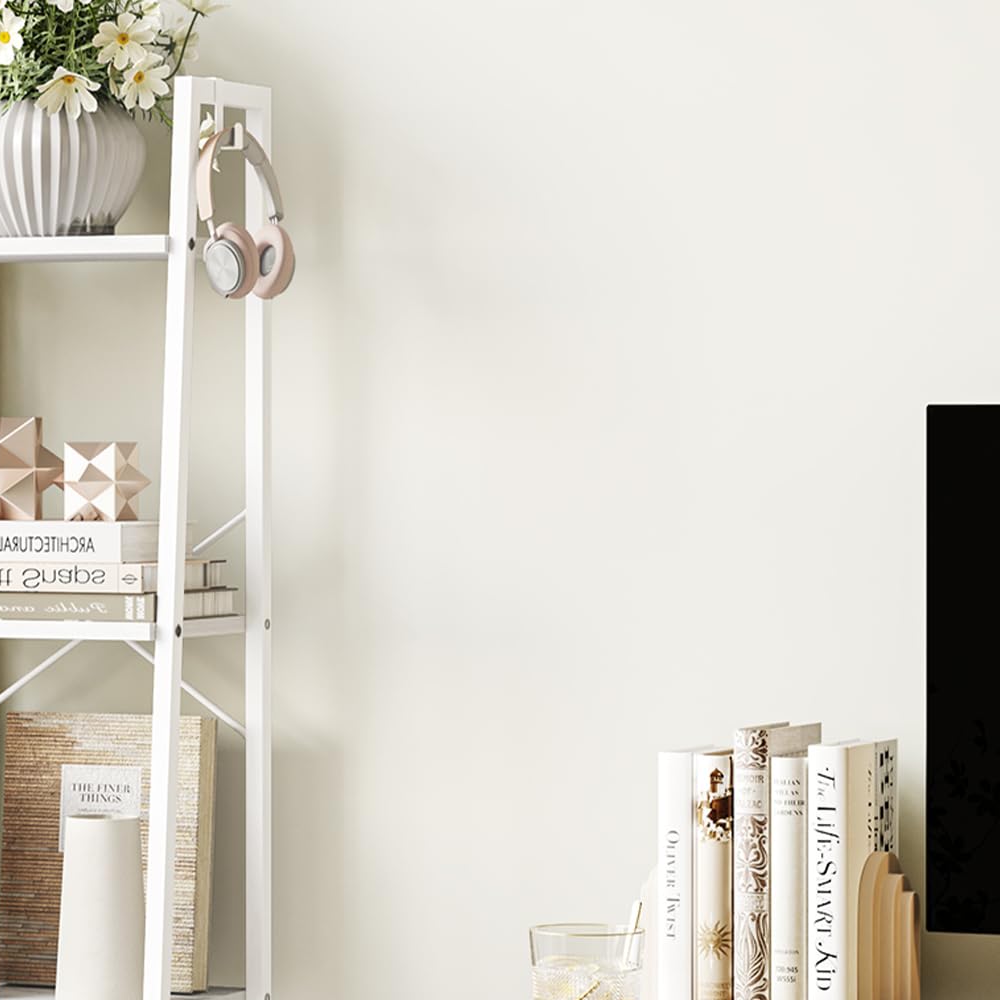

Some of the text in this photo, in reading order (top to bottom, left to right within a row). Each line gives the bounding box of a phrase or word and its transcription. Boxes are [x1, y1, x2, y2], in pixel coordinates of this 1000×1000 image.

[72, 783, 131, 793] THE FINER
[80, 793, 122, 803] THINGS
